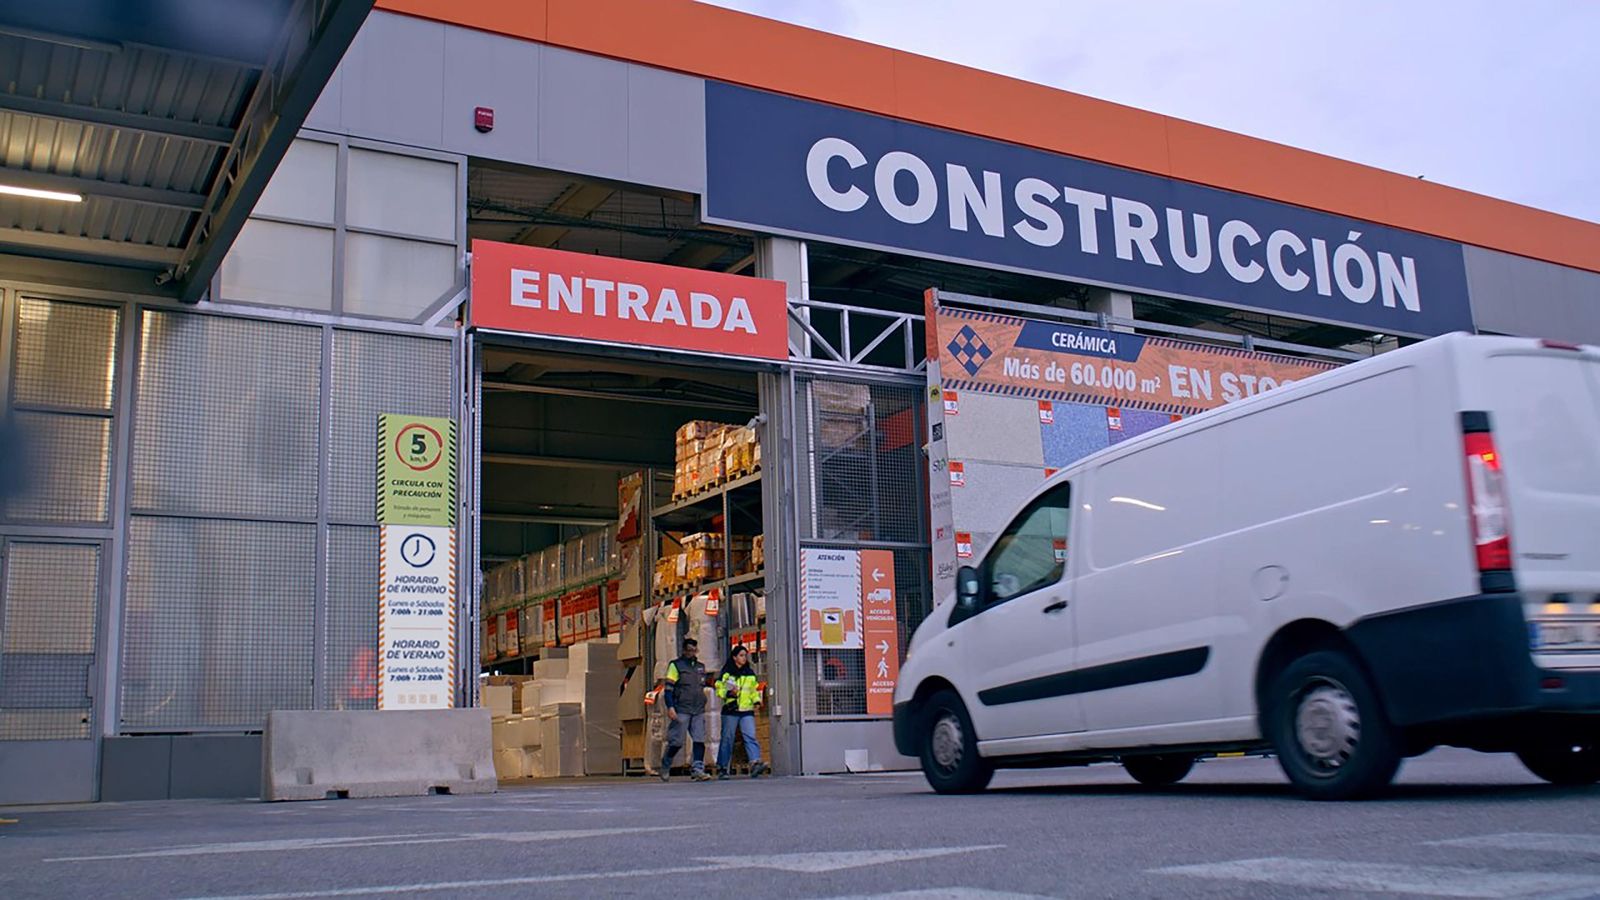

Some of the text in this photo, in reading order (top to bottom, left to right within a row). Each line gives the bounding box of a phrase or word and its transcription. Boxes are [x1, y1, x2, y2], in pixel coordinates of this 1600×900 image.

[806, 137, 1421, 312] CONSTRUCCIÓN
[510, 268, 758, 335] ENTRADA
[1052, 331, 1117, 354] CERÁMICA
[1003, 357, 1040, 380] Más
[1045, 361, 1066, 383] de
[1070, 362, 1137, 391] 60.000
[1168, 364, 1213, 401] EN
[411, 433, 427, 455] 5
[391, 480, 443, 489] CIRCULA CON
[392, 489, 442, 498] PRECAUCIÓN
[394, 575, 439, 584] HORARIO
[387, 584, 447, 594] DE INVIERNO
[392, 639, 440, 649] HORARIO
[386, 650, 446, 660] DE VERANO
